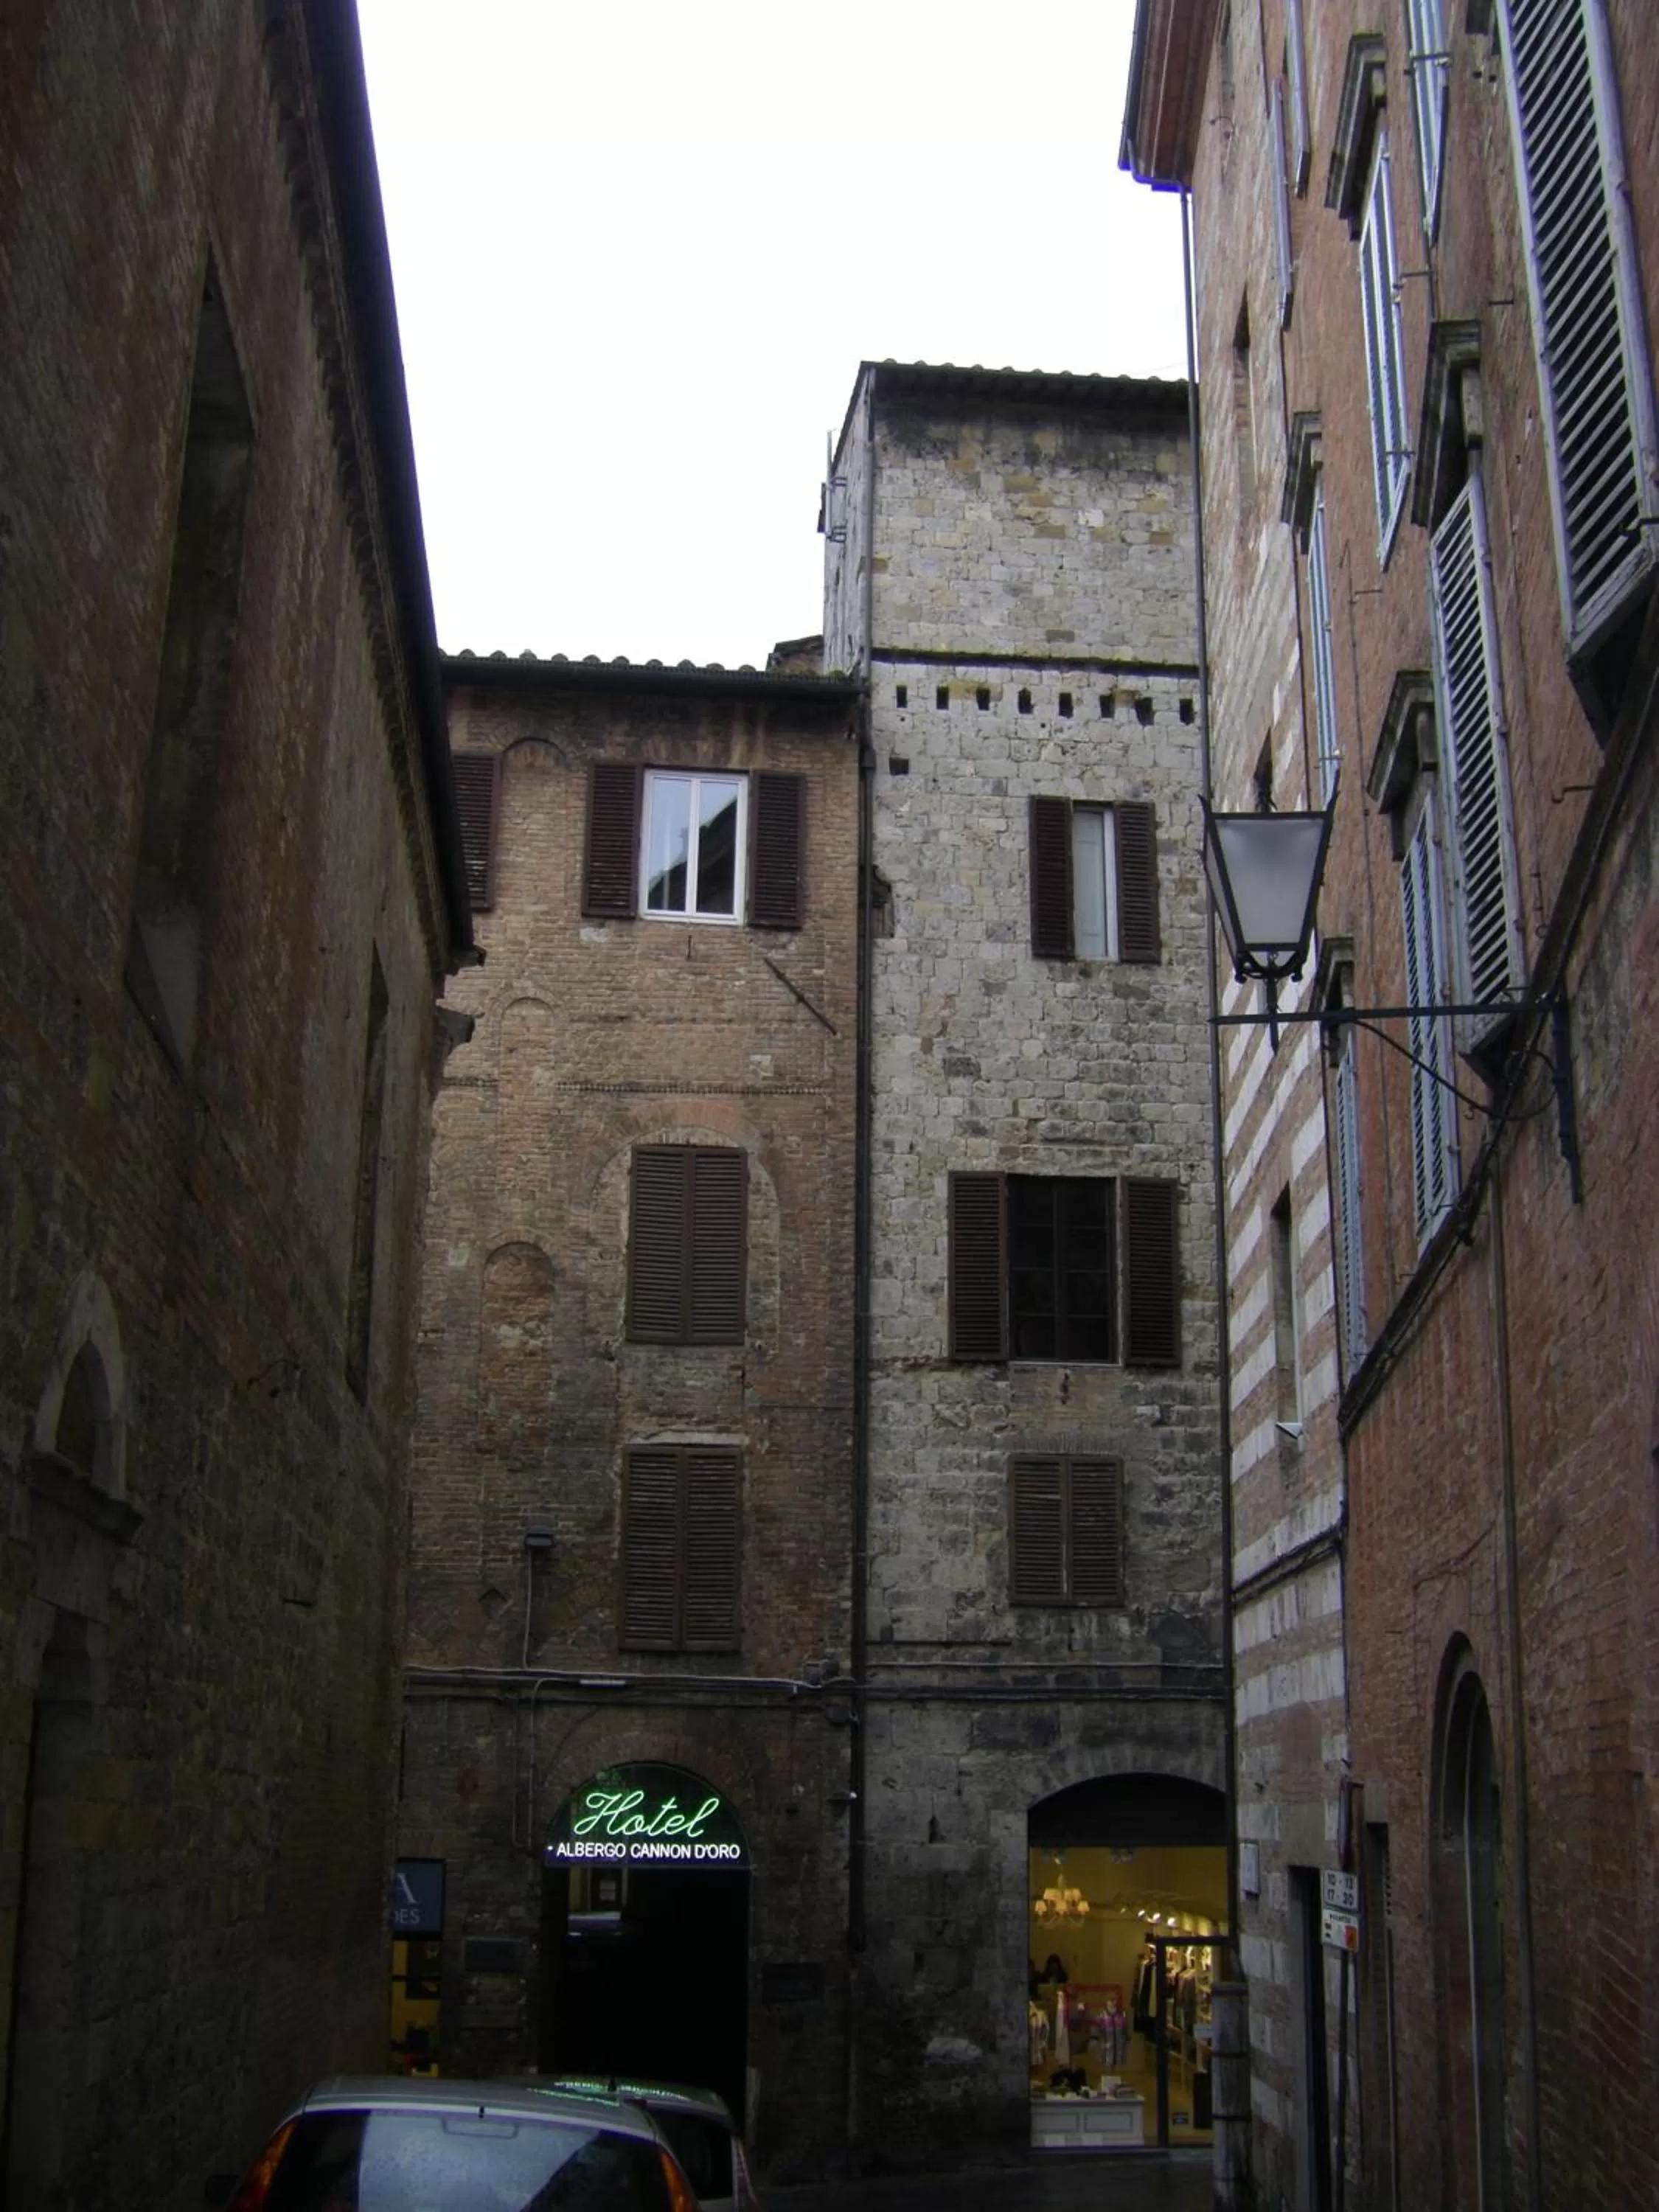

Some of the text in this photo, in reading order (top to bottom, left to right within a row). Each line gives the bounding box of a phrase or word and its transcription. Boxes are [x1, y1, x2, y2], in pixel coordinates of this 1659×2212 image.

[573, 1790, 720, 1837] Hotel
[557, 1843, 741, 1859] ALBERGO CANNON D'ORO
